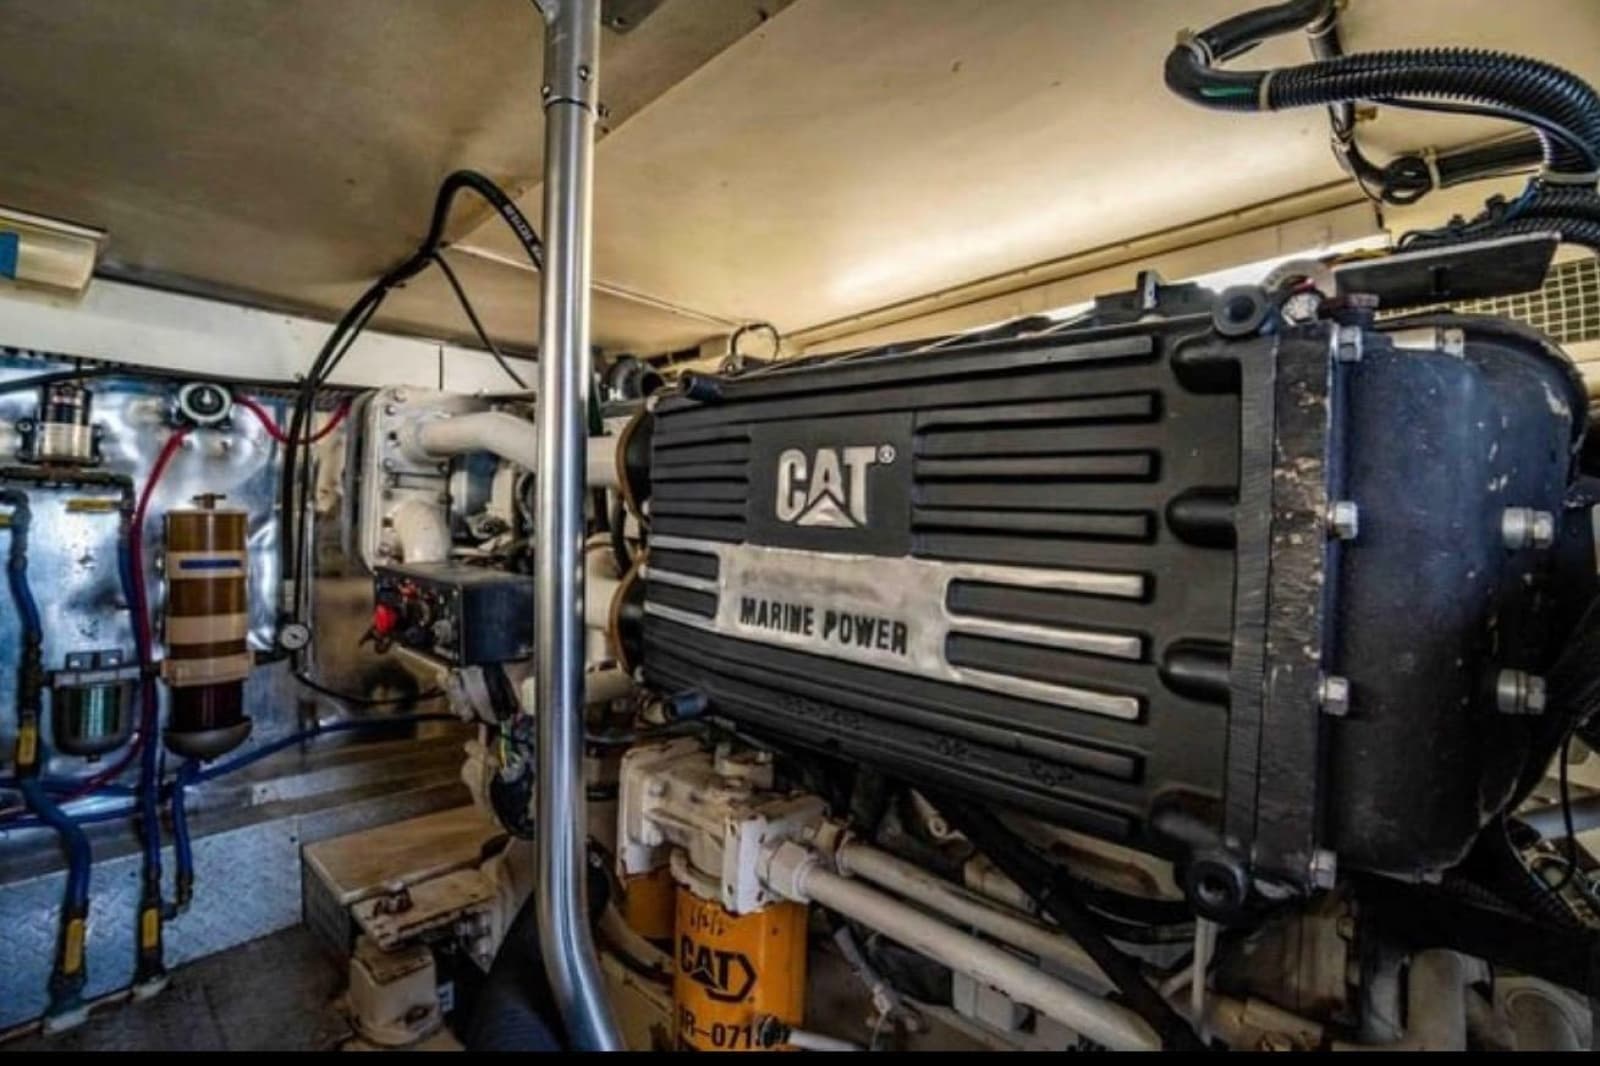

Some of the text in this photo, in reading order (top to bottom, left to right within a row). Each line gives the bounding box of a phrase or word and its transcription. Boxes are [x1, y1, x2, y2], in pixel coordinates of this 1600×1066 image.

[740, 597, 908, 655] MARINE POWER
[681, 935, 737, 992] CAT
